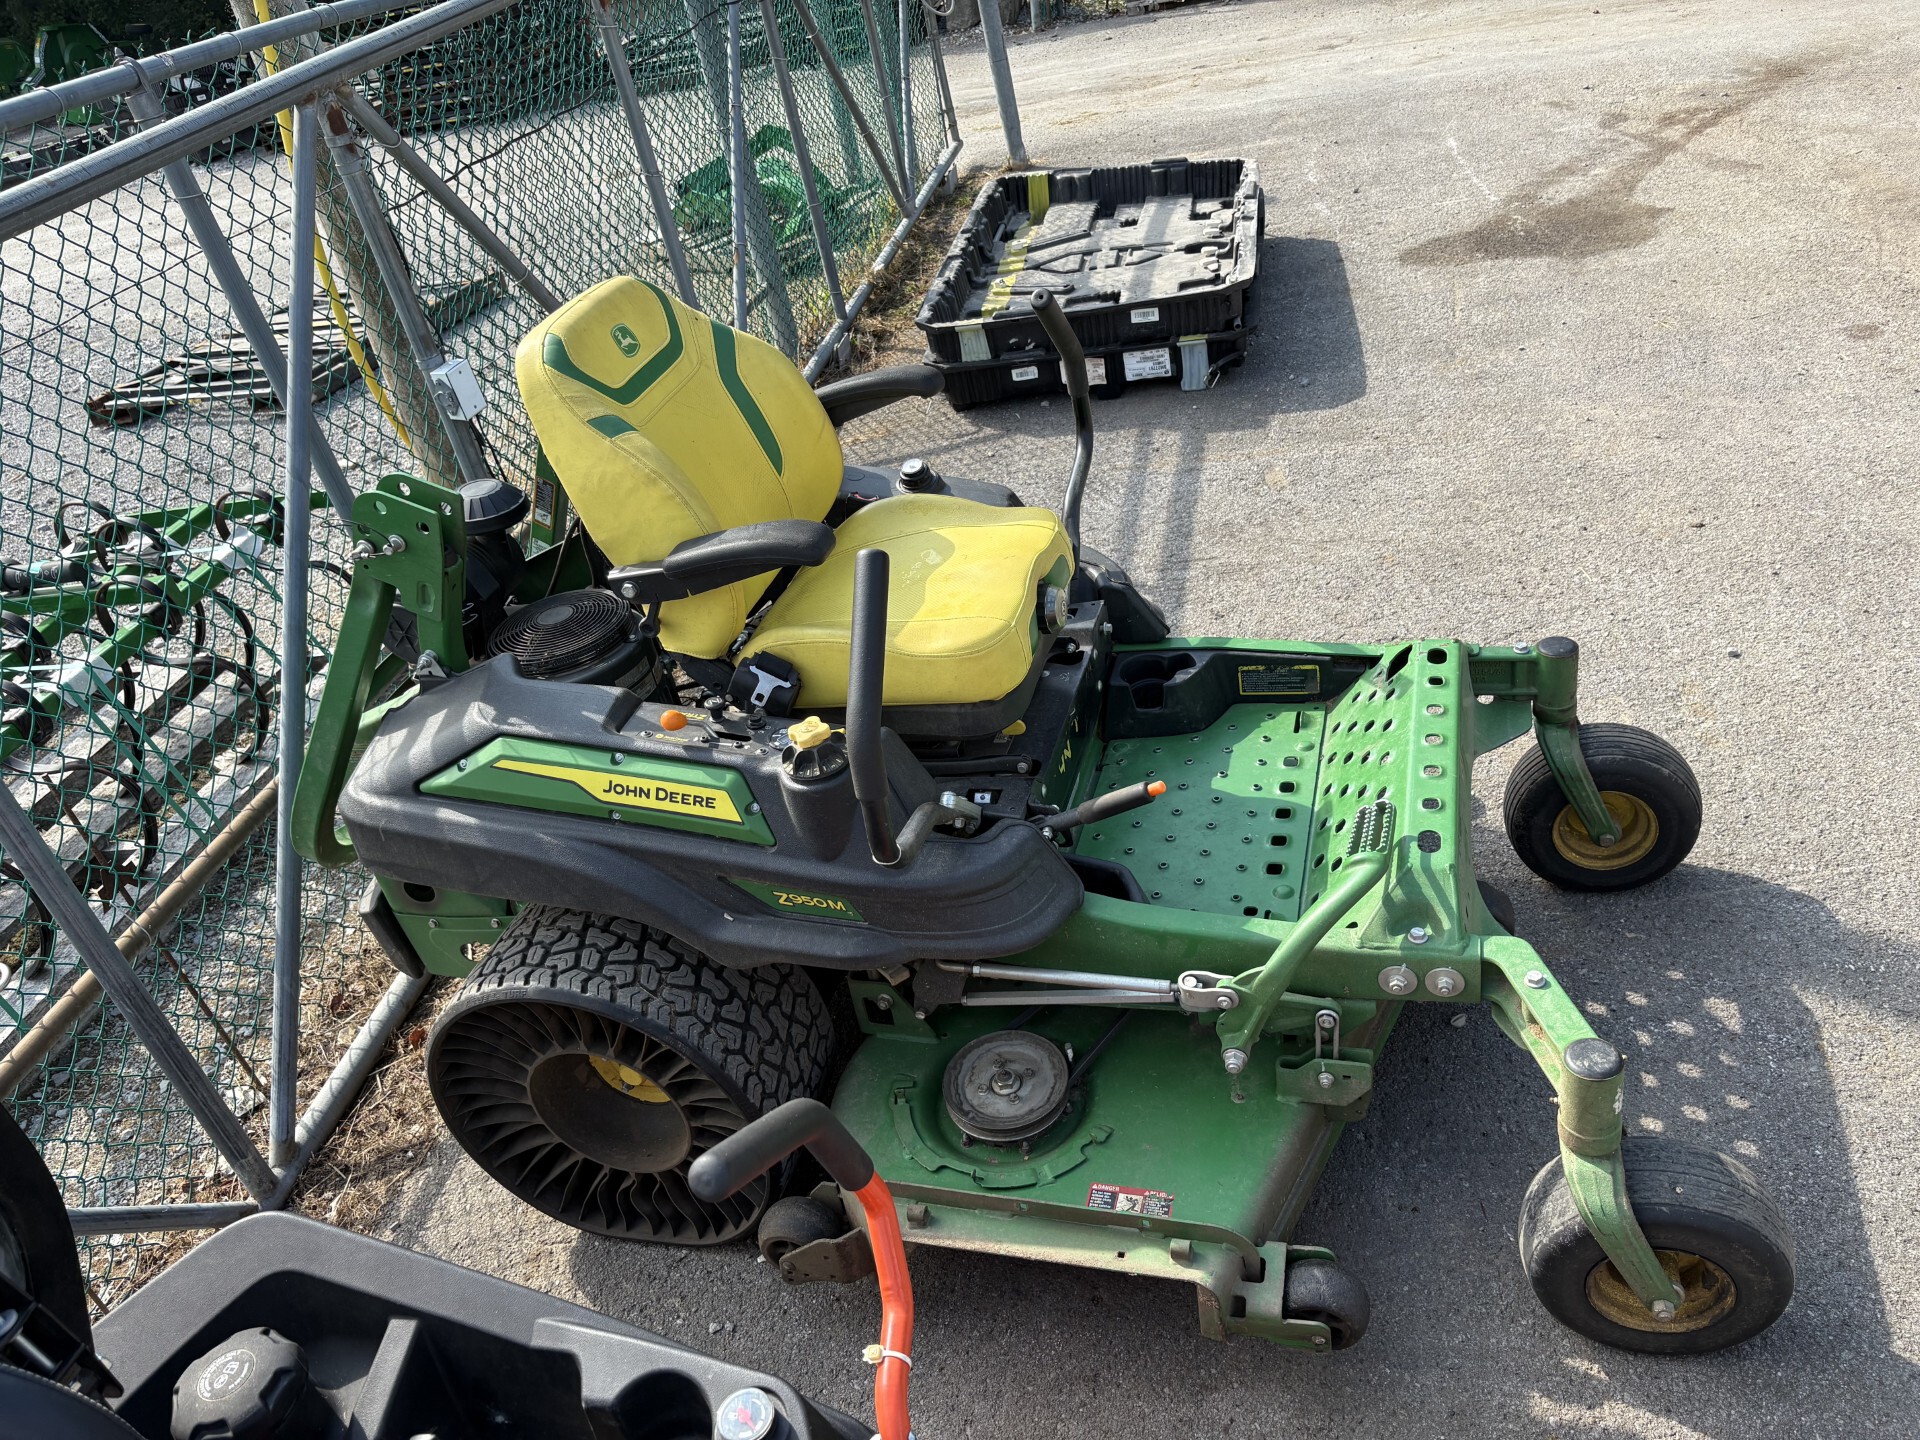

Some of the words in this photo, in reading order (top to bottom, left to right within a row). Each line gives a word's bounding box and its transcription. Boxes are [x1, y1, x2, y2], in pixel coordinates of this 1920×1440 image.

[602, 779, 651, 799] JOHN
[655, 787, 717, 809] DEERE
[772, 891, 847, 911] Z950M
[502, 989, 527, 999] TURF
